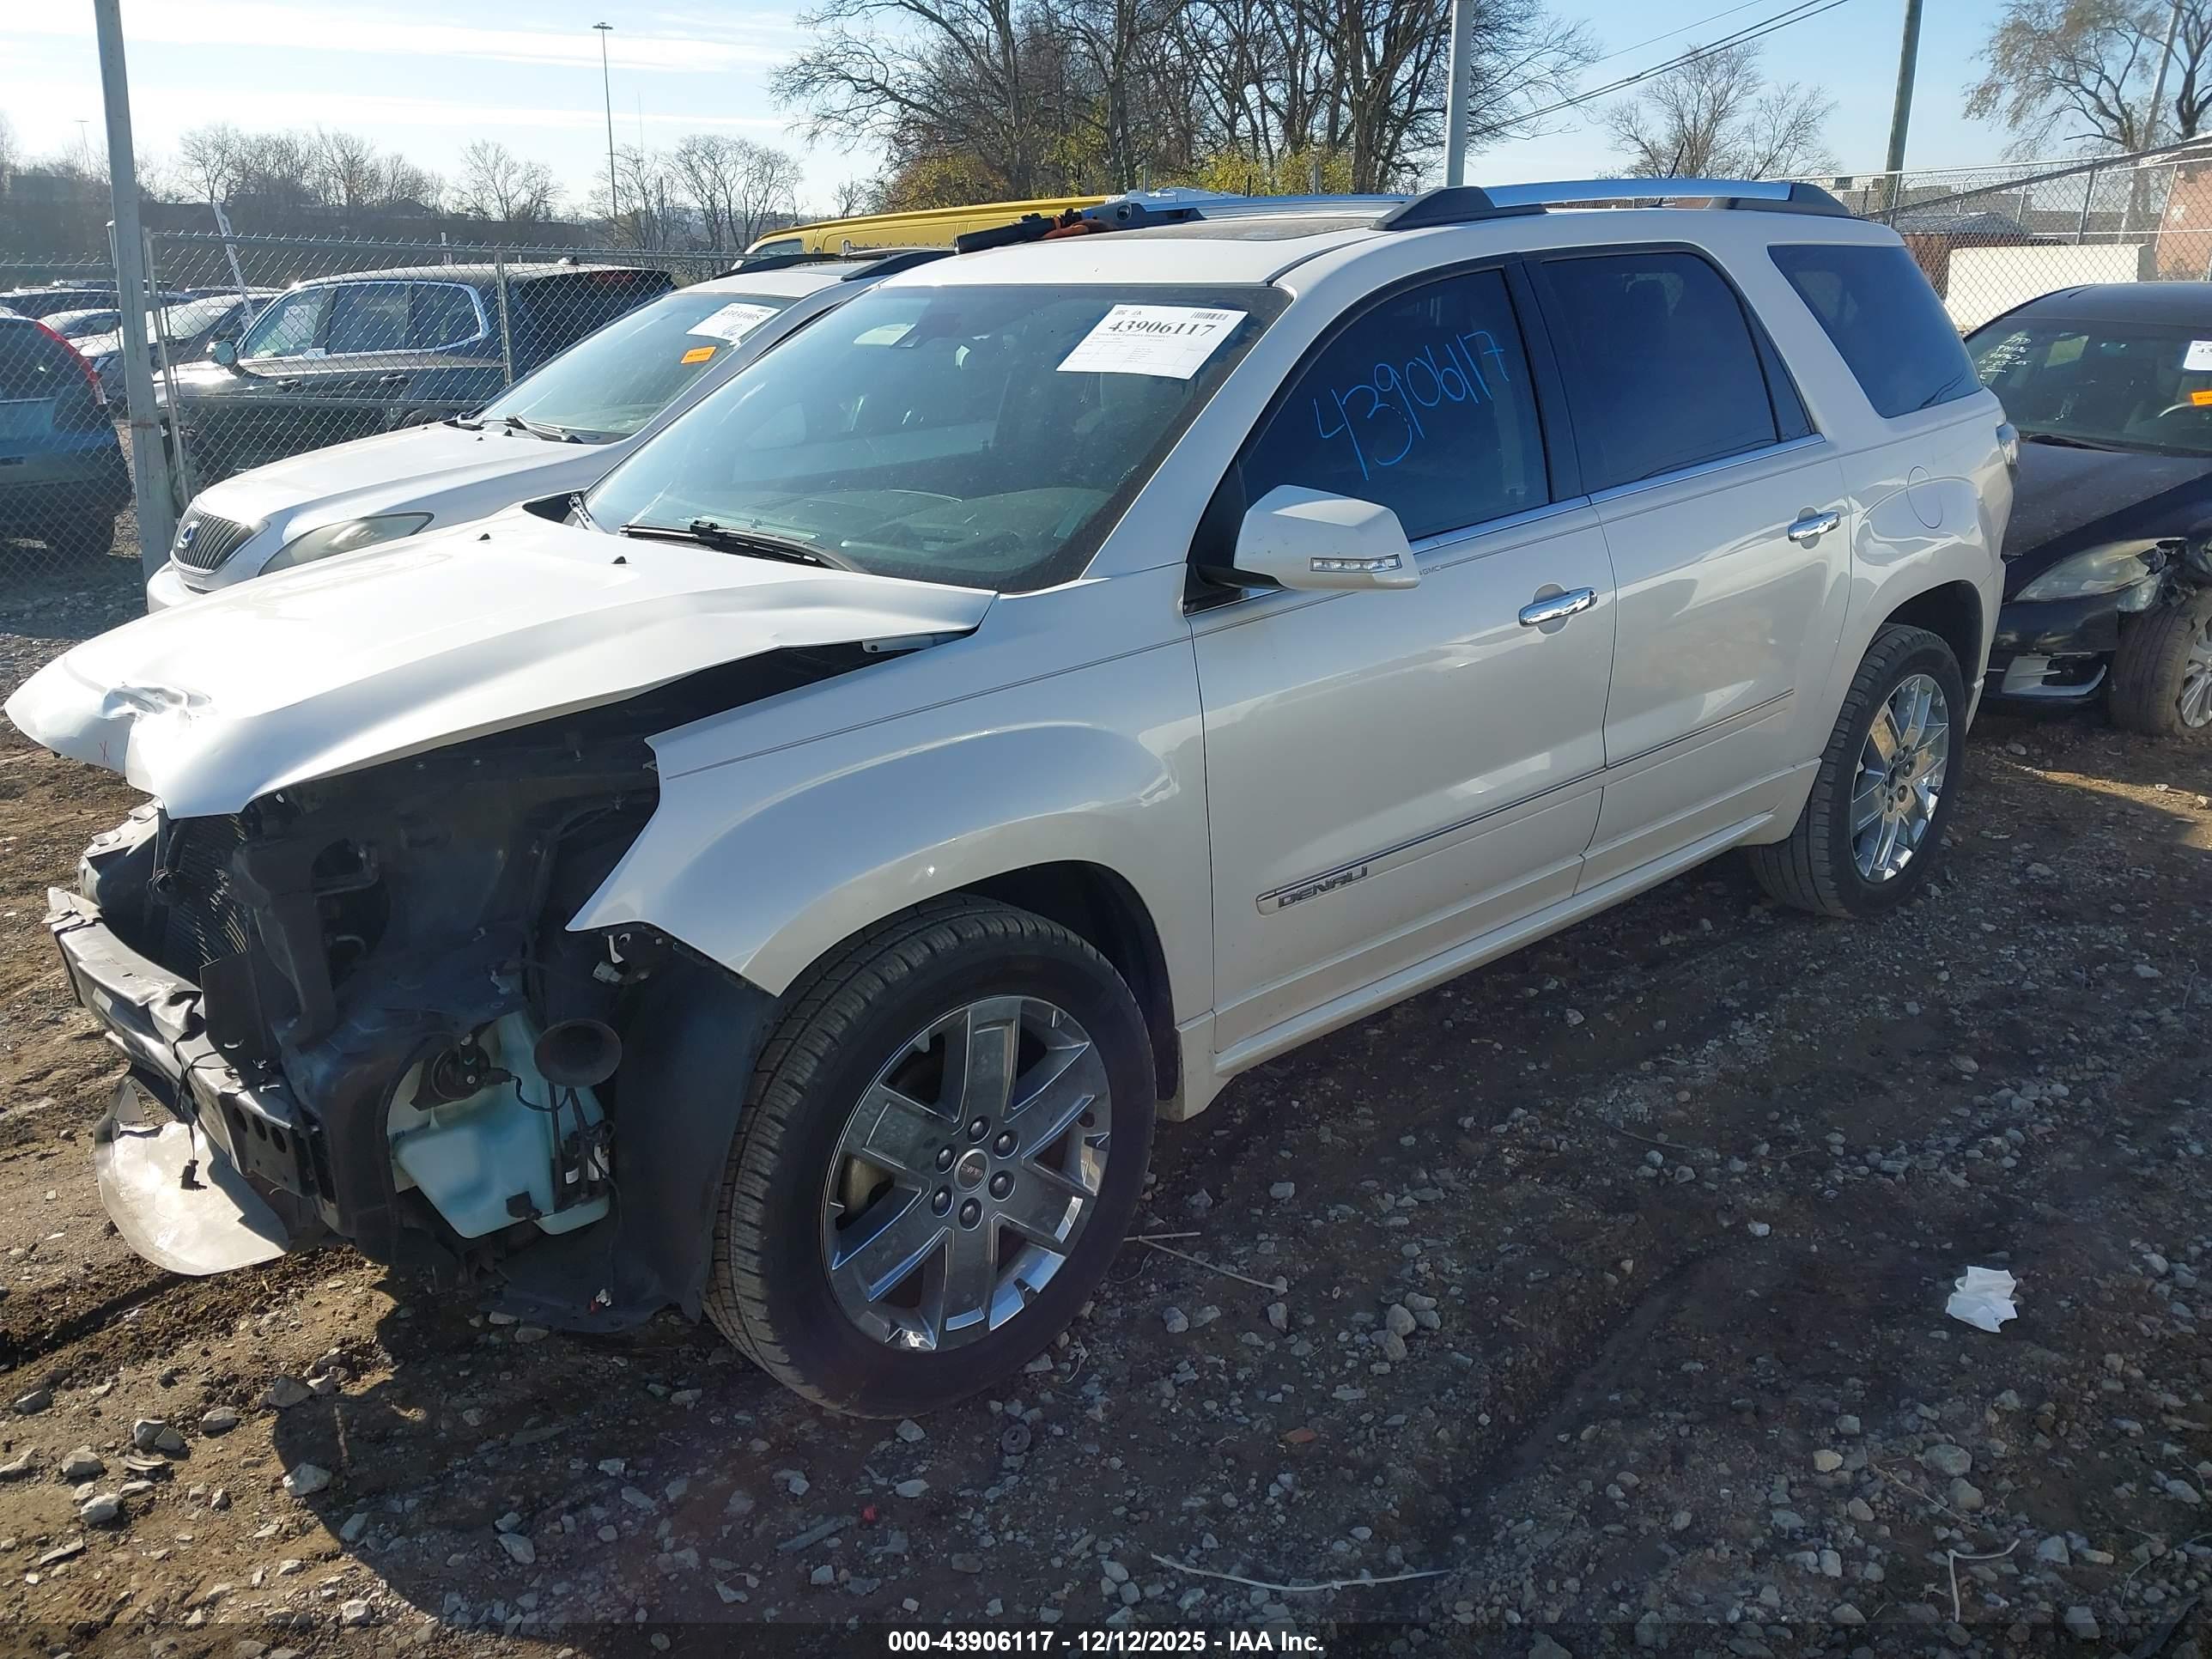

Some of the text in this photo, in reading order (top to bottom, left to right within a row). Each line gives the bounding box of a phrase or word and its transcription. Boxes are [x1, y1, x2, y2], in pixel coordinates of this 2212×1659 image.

[1108, 319, 1216, 337] 43906117
[1313, 330, 1510, 482] 43906117
[1278, 865, 1367, 908] DENALI
